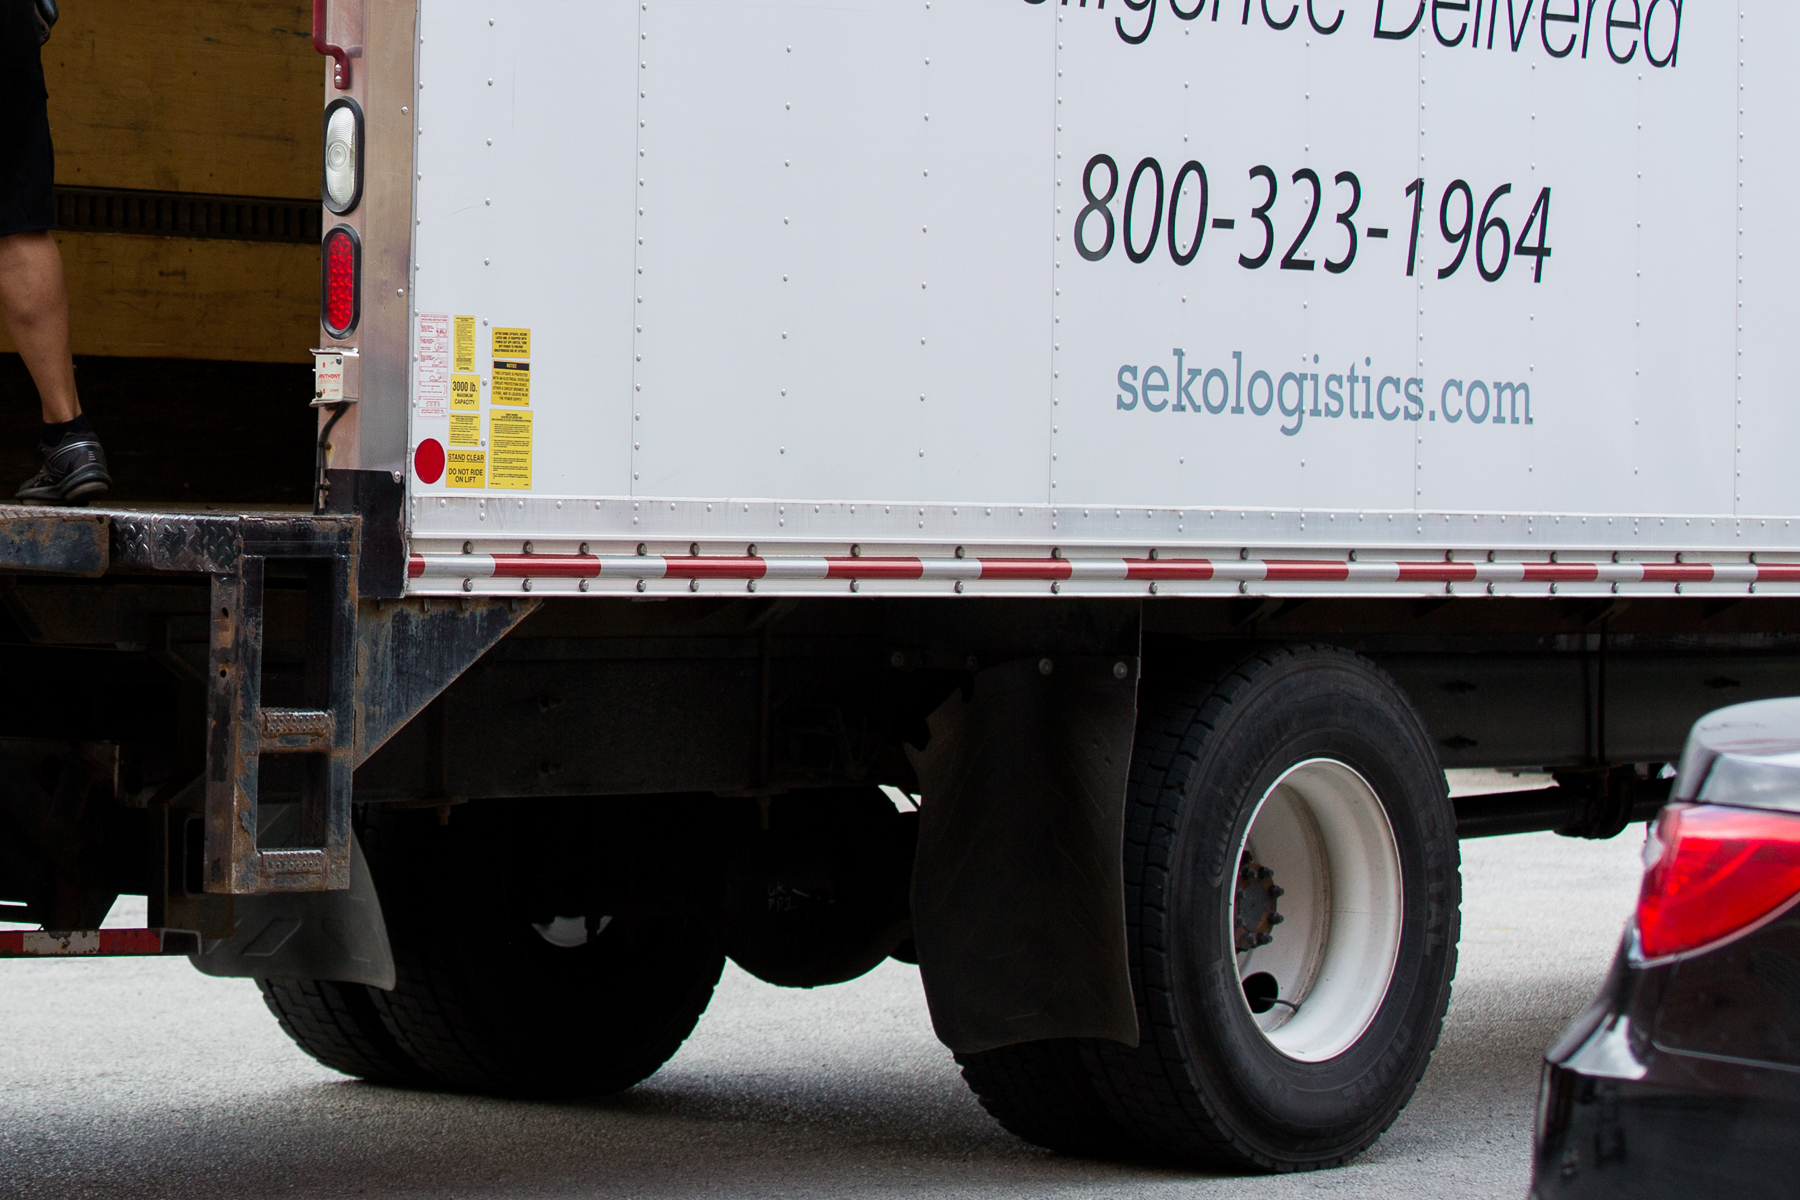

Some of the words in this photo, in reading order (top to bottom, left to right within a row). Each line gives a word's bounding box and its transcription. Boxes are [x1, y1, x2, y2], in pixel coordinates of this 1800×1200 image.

[1073, 152, 1553, 284] 800-323-1964
[453, 381, 468, 392] 3000
[1115, 347, 1535, 437] sekologistics.com
